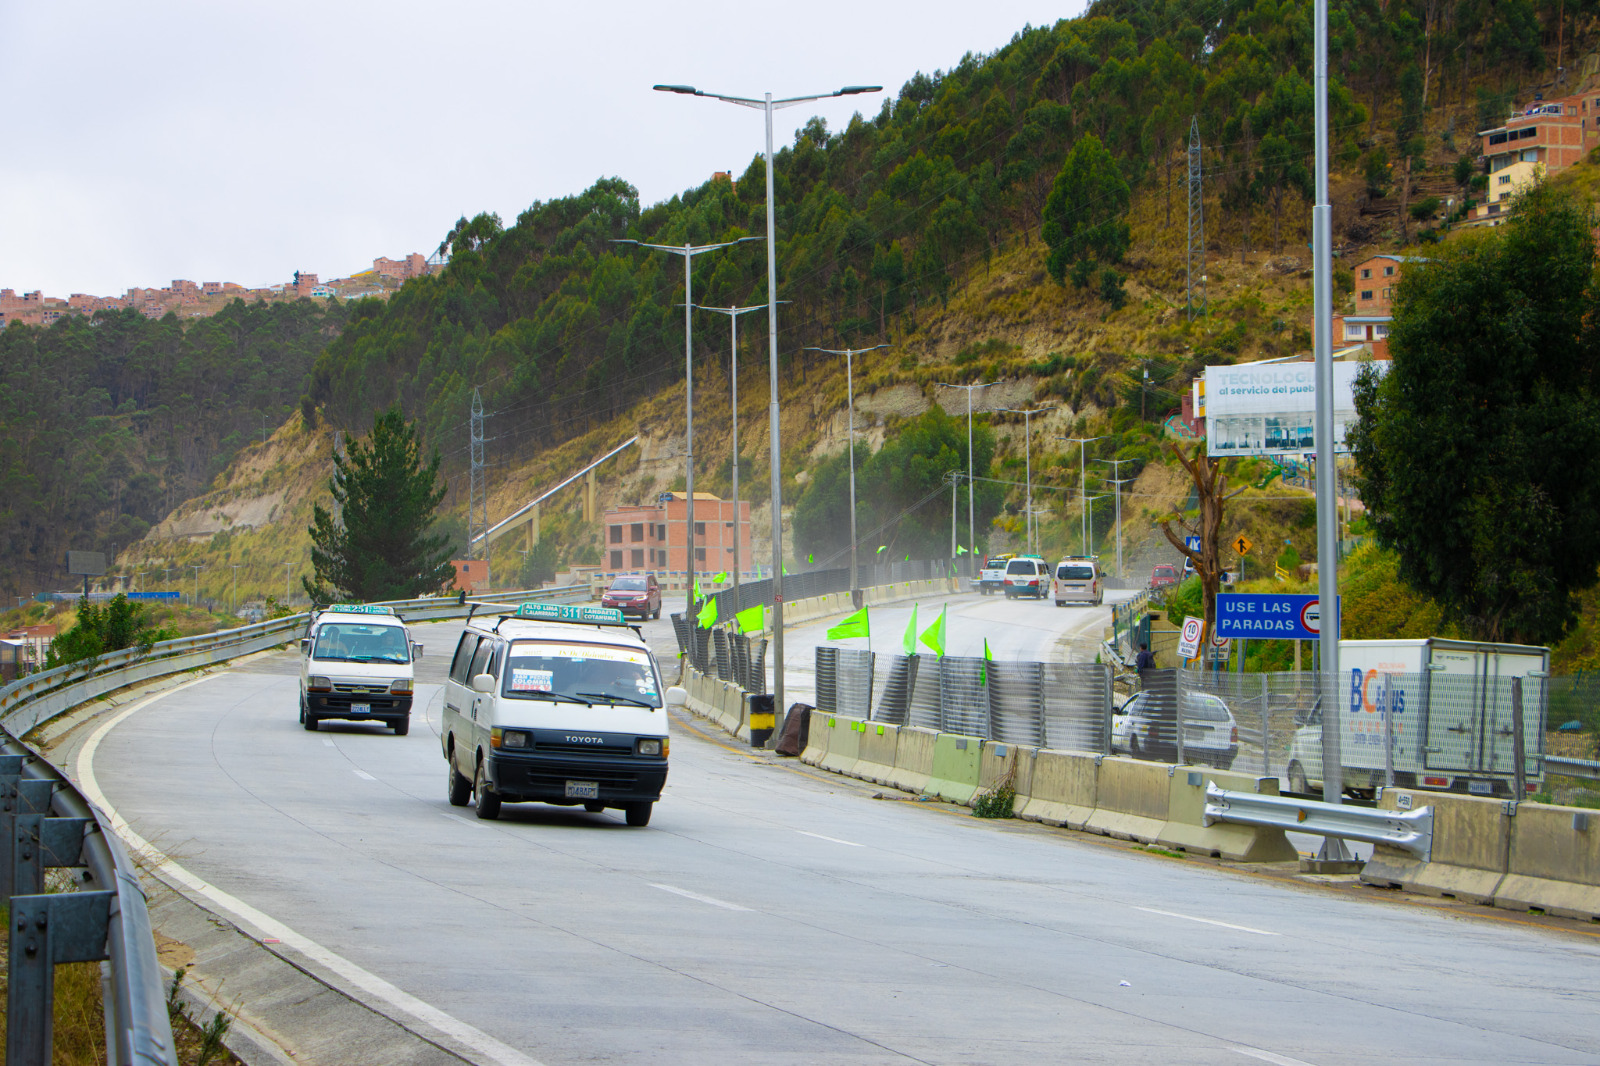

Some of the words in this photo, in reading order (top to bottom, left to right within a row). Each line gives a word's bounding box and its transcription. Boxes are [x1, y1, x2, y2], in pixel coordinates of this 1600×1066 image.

[1219, 368, 1315, 385] TECNOLOGÍ
[1219, 387, 1228, 395] al
[1231, 386, 1270, 395] servicio
[1272, 385, 1287, 394] del
[1289, 385, 1315, 394] pueb
[562, 607, 580, 619] 311
[1225, 601, 1256, 613] USE
[1263, 602, 1292, 613] LAS
[1188, 624, 1196, 634] 10
[1222, 619, 1295, 631] PARADAS
[565, 735, 604, 744] TOYOTA
